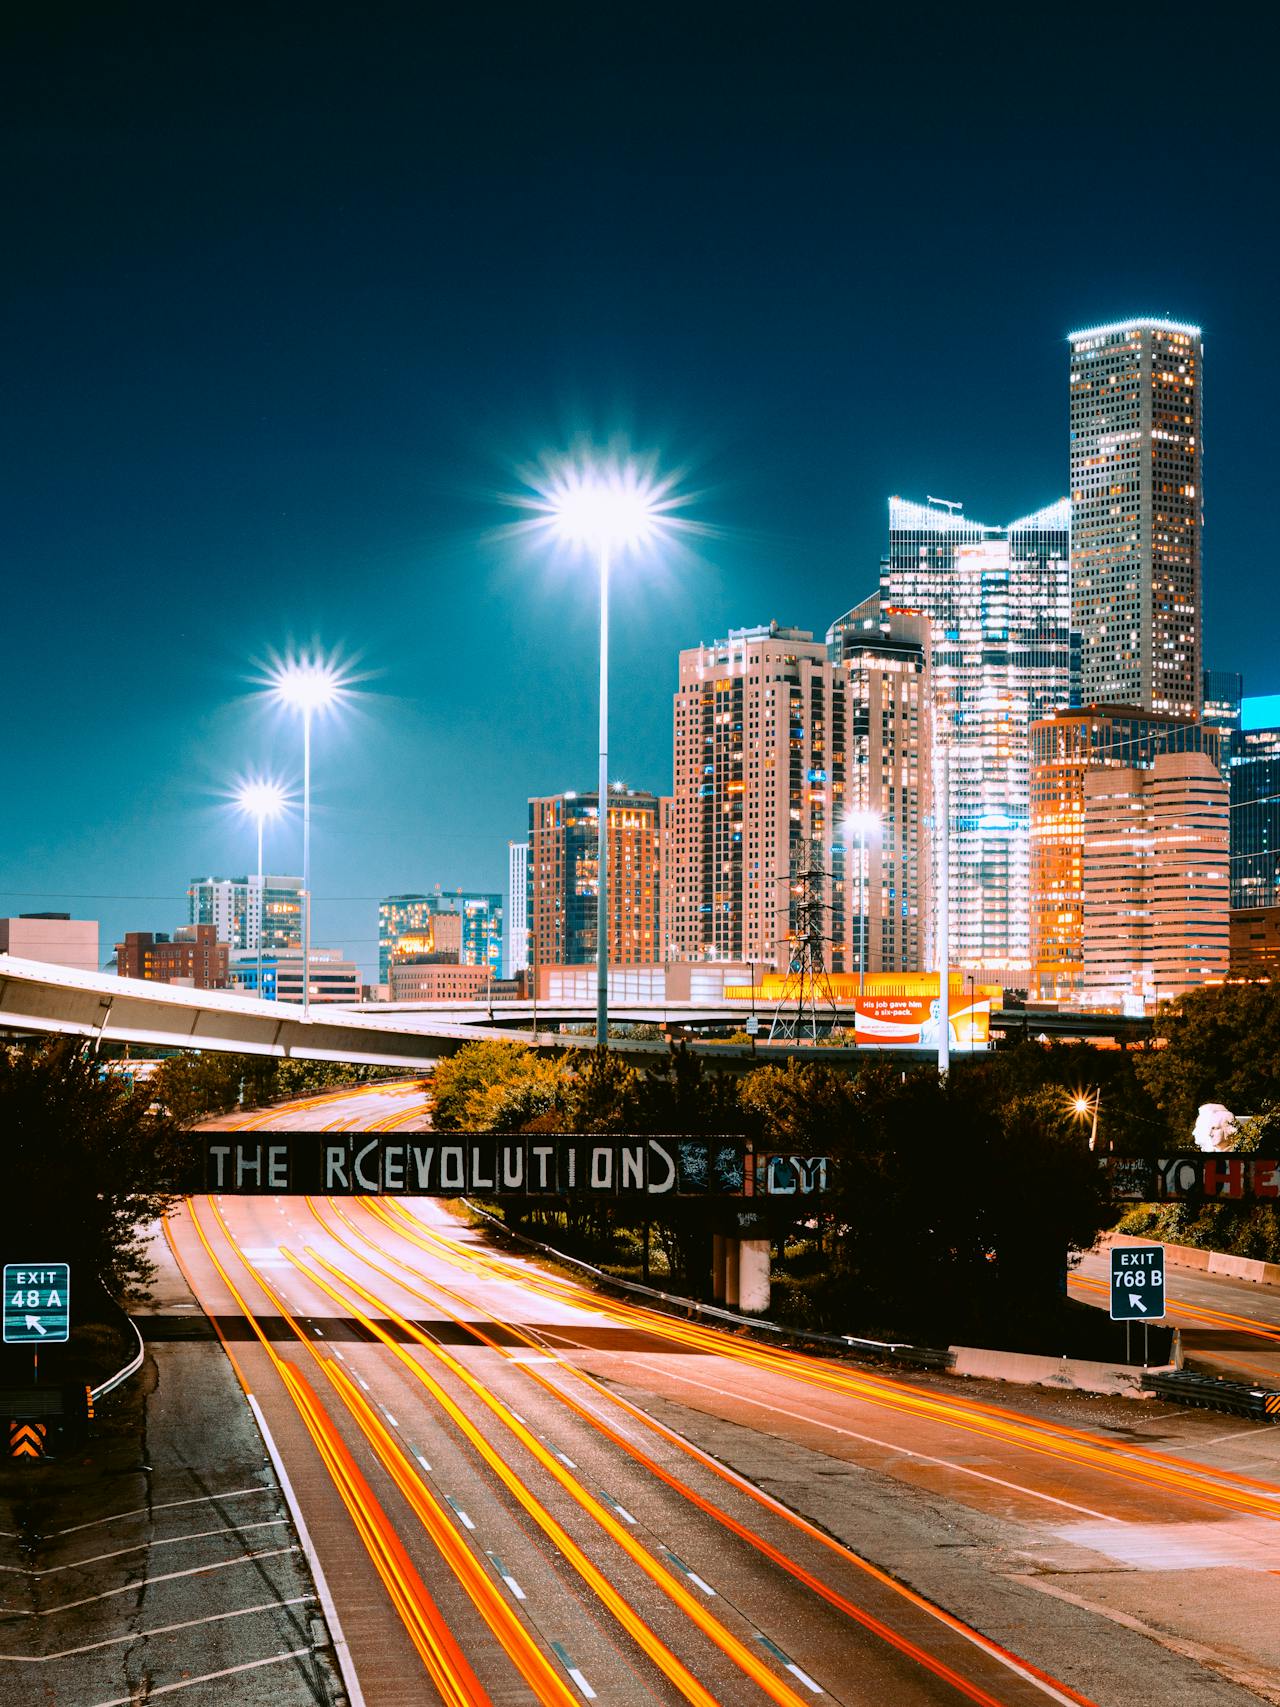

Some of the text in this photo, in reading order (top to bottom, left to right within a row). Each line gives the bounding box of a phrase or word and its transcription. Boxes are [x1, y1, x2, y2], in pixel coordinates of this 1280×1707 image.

[876, 1001, 888, 1009] job
[209, 1145, 288, 1188] THE
[1121, 1253, 1155, 1266] EXIT
[17, 1271, 57, 1285] EXIT
[1113, 1269, 1163, 1288] 768 B
[11, 1289, 62, 1308] 48 A
